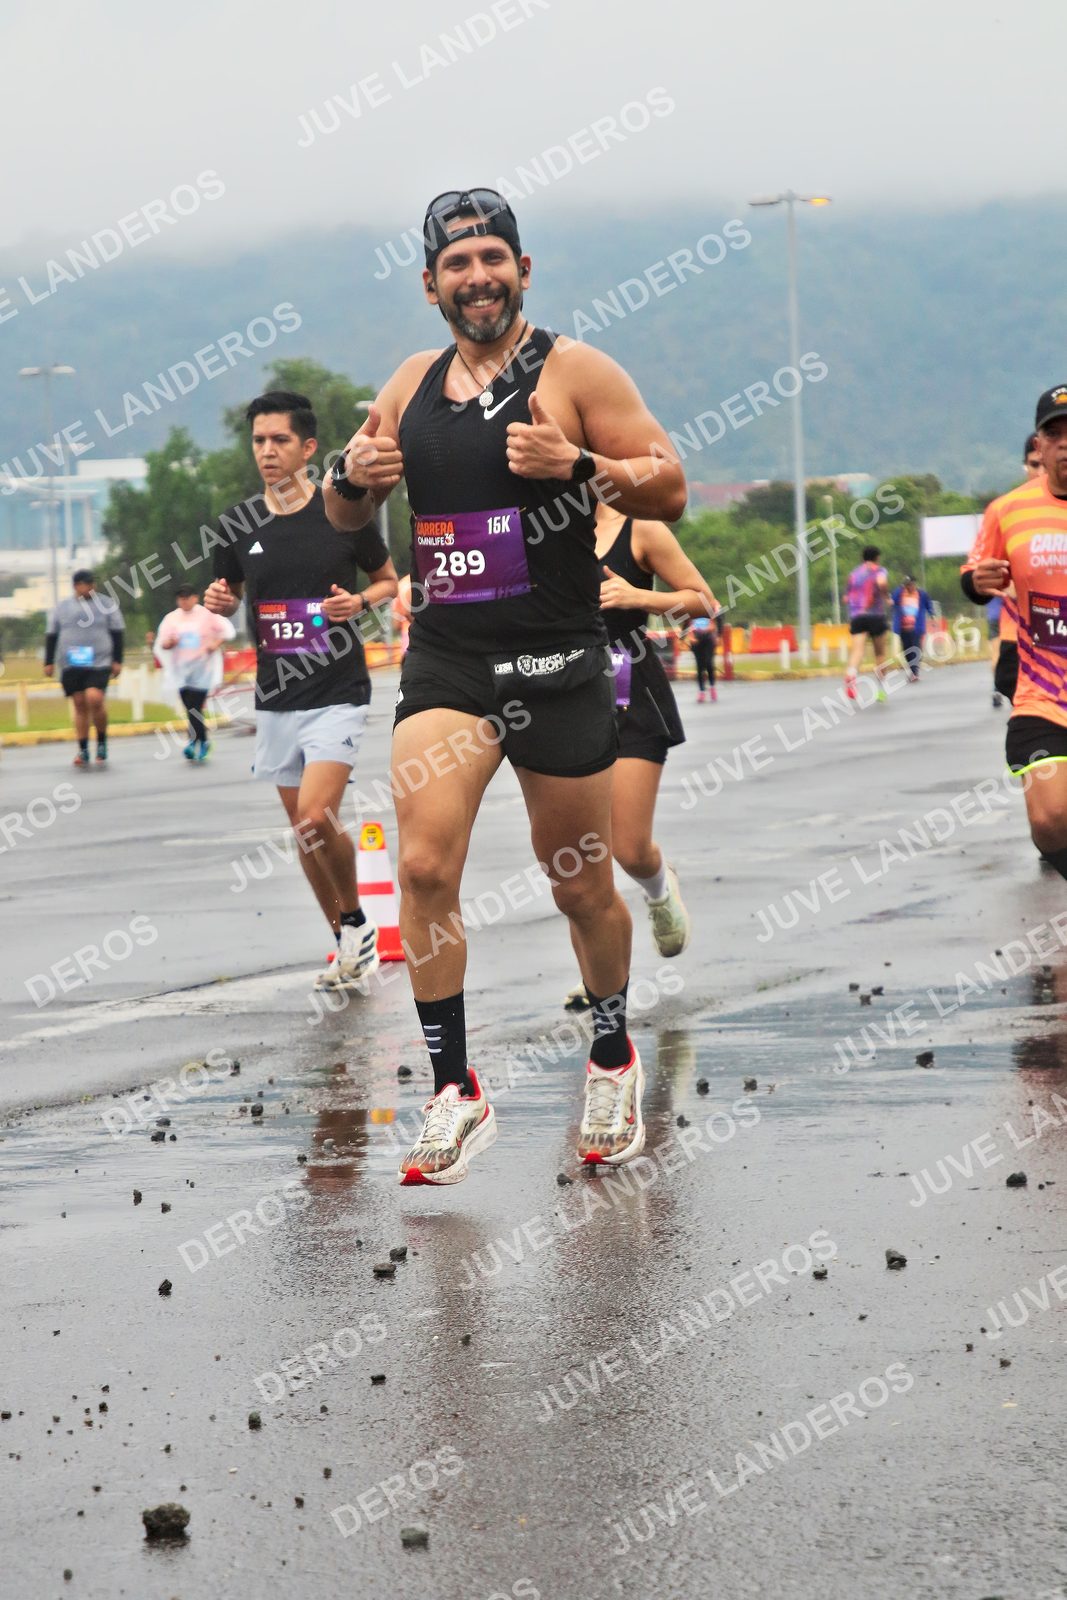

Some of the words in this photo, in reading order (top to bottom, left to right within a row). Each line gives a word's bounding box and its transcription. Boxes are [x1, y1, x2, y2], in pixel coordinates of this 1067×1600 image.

[487, 515, 511, 535] 15K
[434, 549, 486, 577] 289
[271, 621, 305, 640] 132
